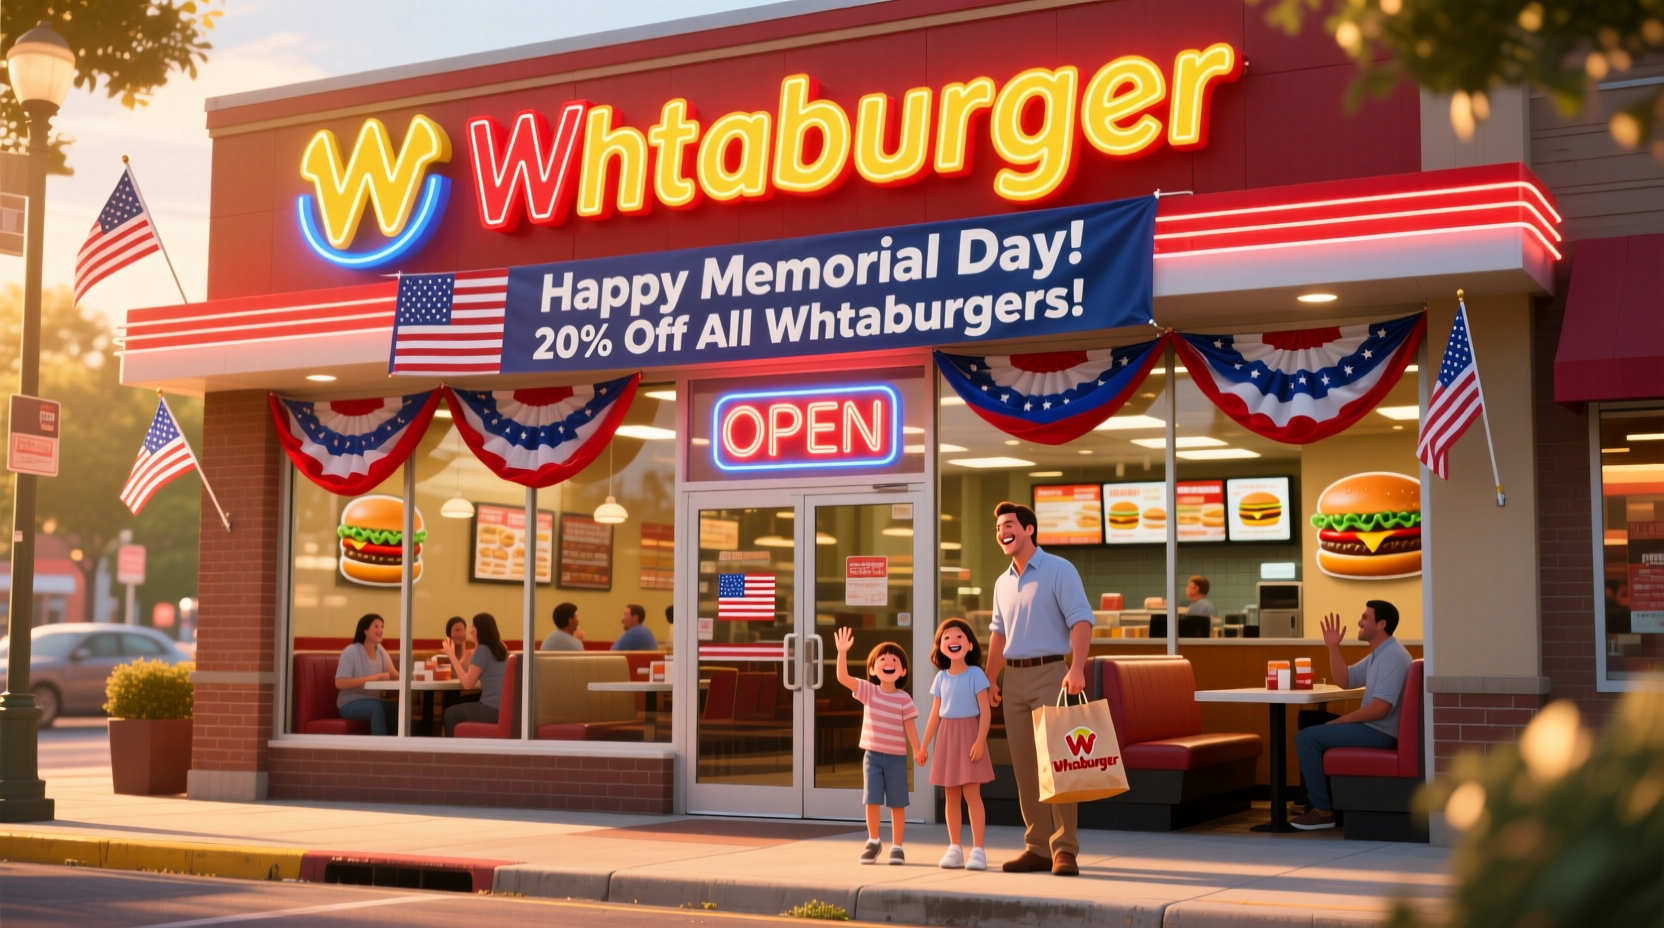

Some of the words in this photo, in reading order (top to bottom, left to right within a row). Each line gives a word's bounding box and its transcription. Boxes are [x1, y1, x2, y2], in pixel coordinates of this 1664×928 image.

[300, 114, 451, 249] W
[466, 42, 1240, 231] Whtaburger
[540, 268, 689, 319] Happy
[701, 232, 941, 300] Memorial
[957, 219, 1085, 281] Day!
[532, 323, 613, 361] 20%
[624, 314, 690, 354] Off
[696, 309, 752, 351] All
[765, 277, 1085, 345] Whtaburgers!
[722, 399, 882, 458] OPEN
[1065, 732, 1096, 757] W
